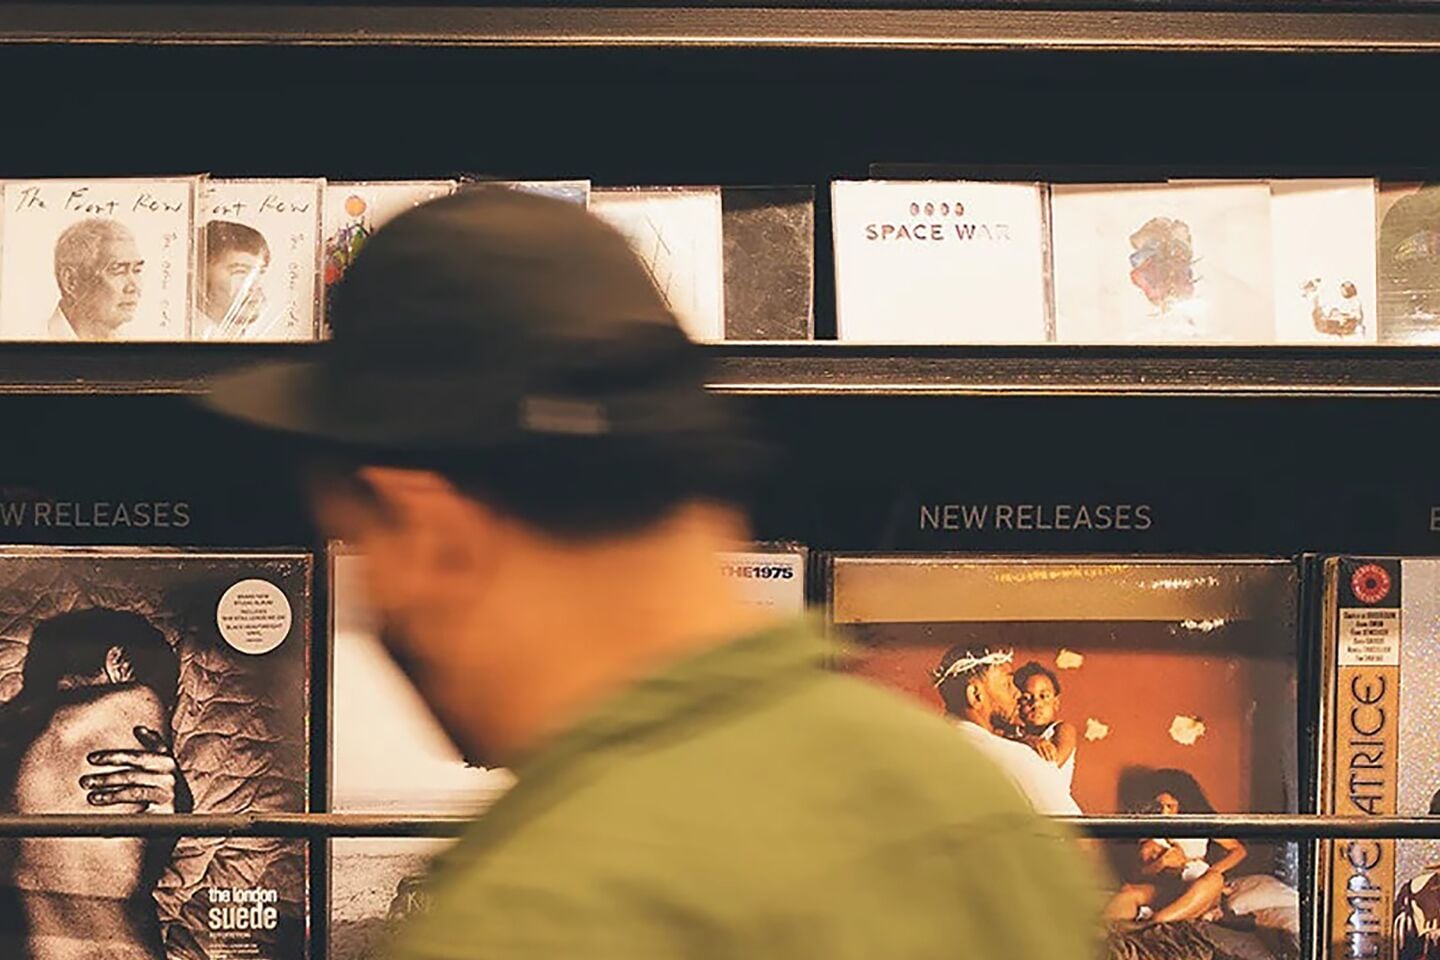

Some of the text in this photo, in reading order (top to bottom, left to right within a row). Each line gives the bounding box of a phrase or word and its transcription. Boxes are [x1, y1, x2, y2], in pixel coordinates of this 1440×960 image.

[16, 187, 46, 212] The
[64, 187, 119, 215] Front
[865, 224, 1010, 241] SPACE WAR
[34, 502, 190, 527] RELEASES
[920, 505, 1152, 530] NEW RELEASES
[208, 886, 277, 903] the london
[208, 902, 278, 930] suede
